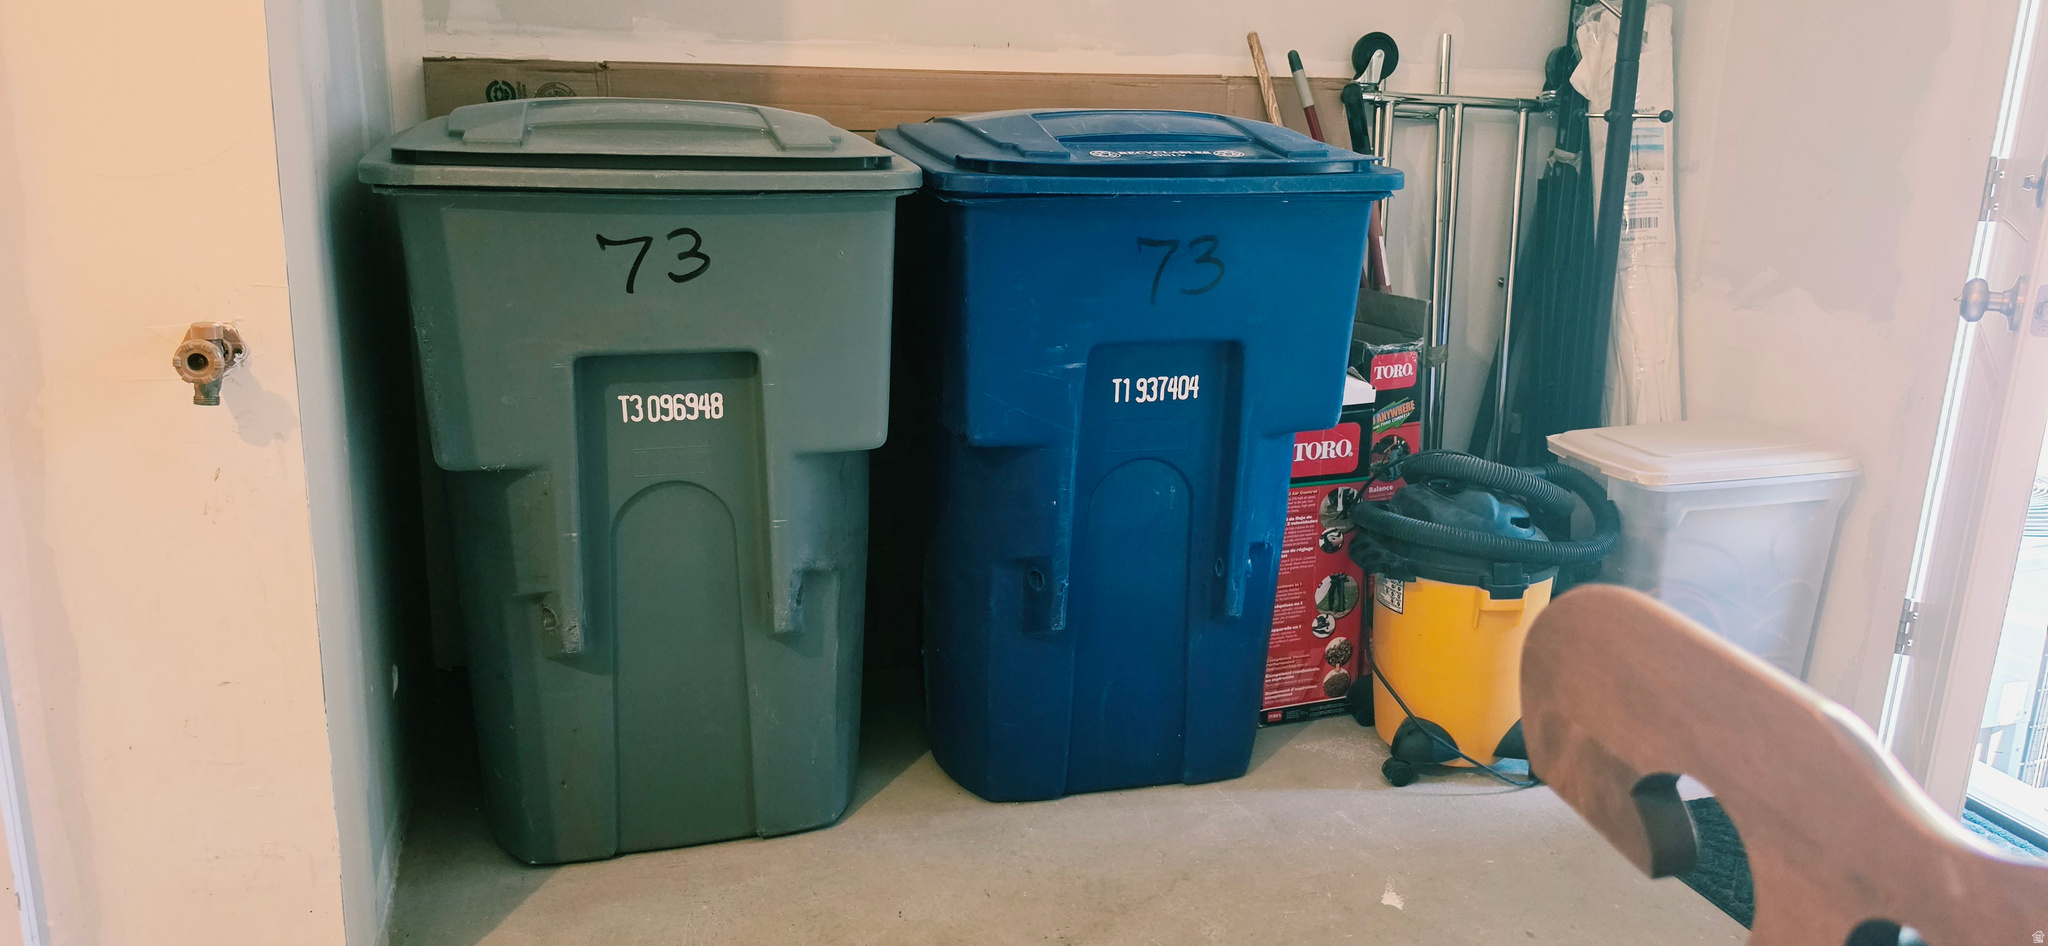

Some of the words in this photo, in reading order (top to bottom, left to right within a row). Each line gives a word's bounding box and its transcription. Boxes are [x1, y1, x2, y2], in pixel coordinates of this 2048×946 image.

[596, 227, 711, 294] 73
[1136, 234, 1226, 305] 73
[1374, 362, 1413, 380] TORO
[1112, 378, 1130, 403] T1
[1135, 374, 1200, 403] 937404
[617, 394, 644, 423] T3
[647, 392, 724, 423] 096948
[1377, 400, 1415, 424] ANYWHERE
[1293, 438, 1353, 462] TORO
[1368, 485, 1394, 493] Balance
